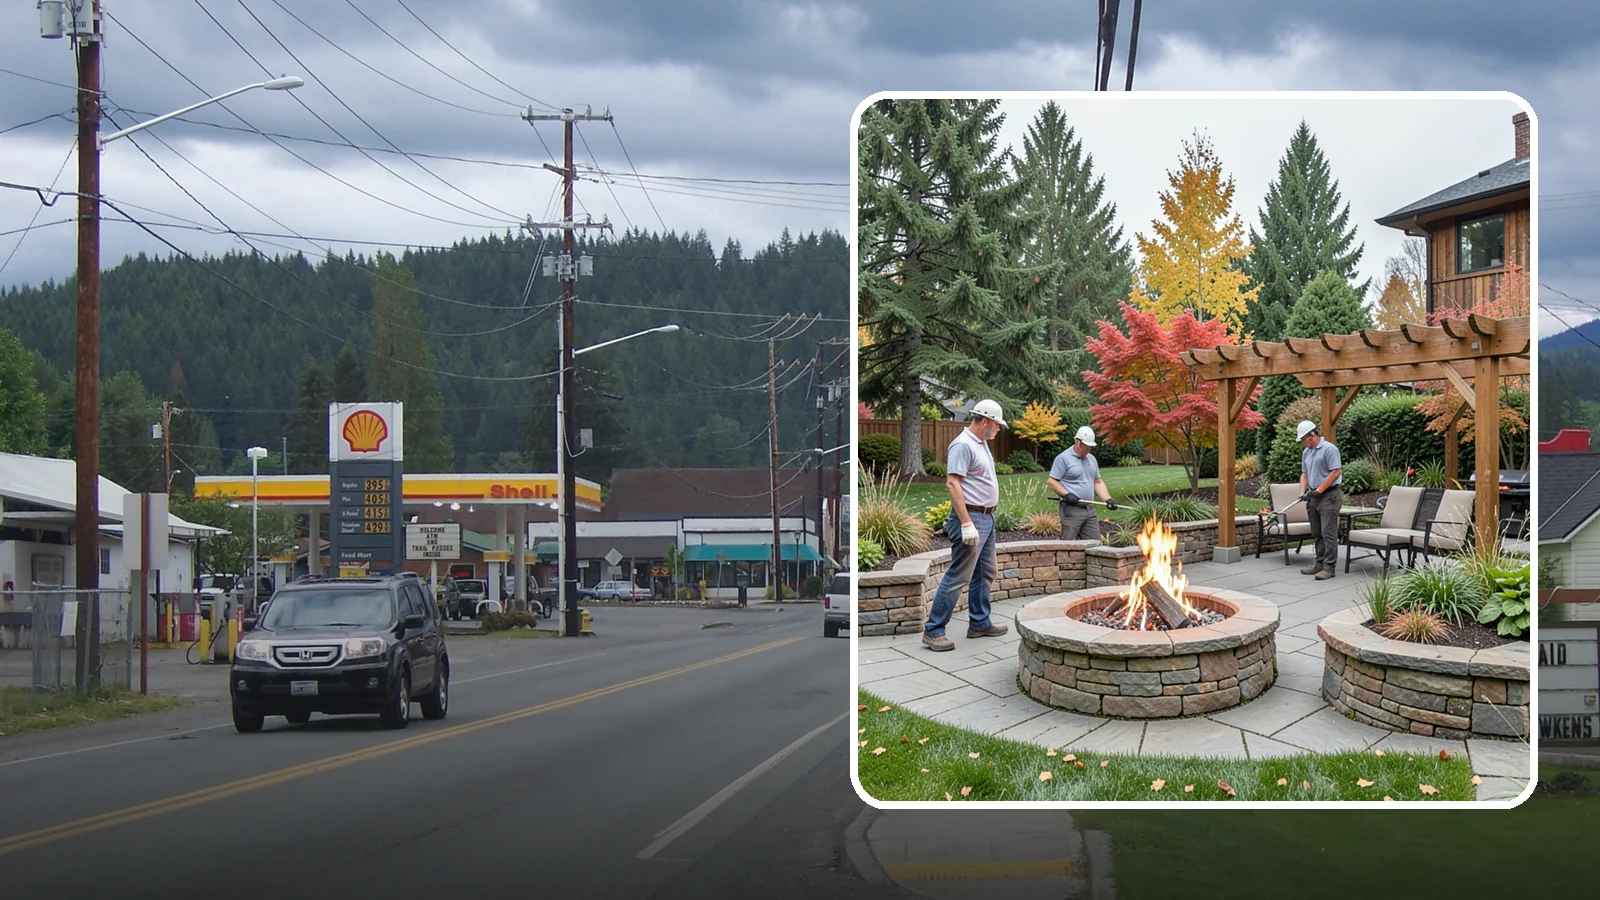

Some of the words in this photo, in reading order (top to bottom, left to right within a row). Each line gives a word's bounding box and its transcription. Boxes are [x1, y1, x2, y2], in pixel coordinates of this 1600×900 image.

[366, 480, 384, 490] 395
[490, 484, 547, 499] Shell
[366, 494, 384, 504] 405
[366, 508, 384, 518] 415
[366, 522, 384, 533] 429
